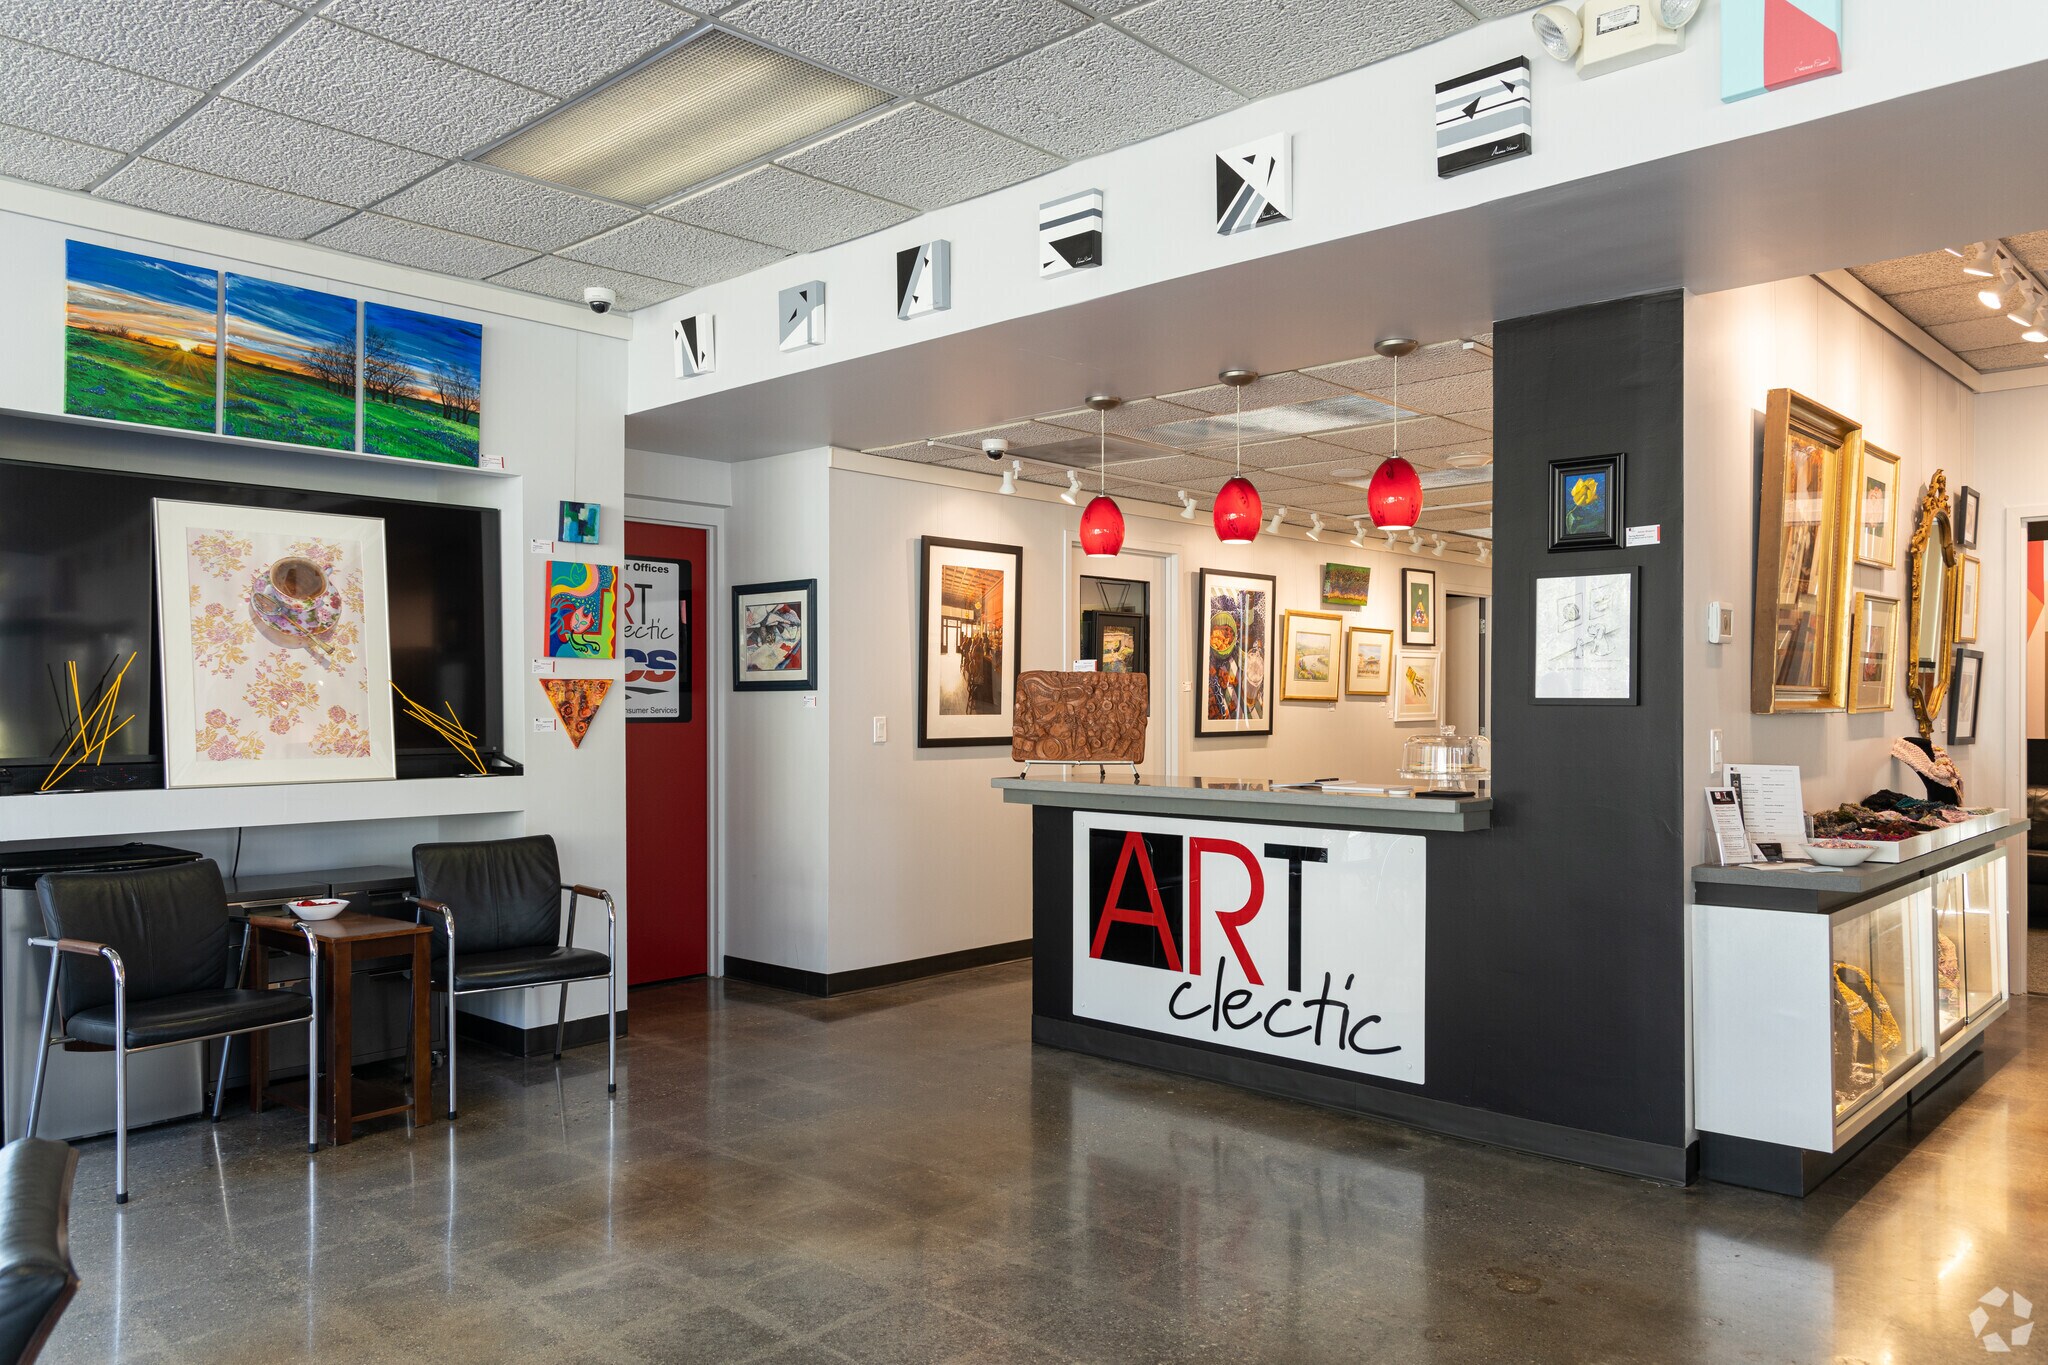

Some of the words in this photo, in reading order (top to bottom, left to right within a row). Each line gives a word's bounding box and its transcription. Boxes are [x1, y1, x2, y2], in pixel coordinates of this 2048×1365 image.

[633, 562, 669, 574] Offices
[650, 706, 678, 715] Services
[1089, 831, 1328, 992] ART
[1168, 956, 1402, 1055] clectic
